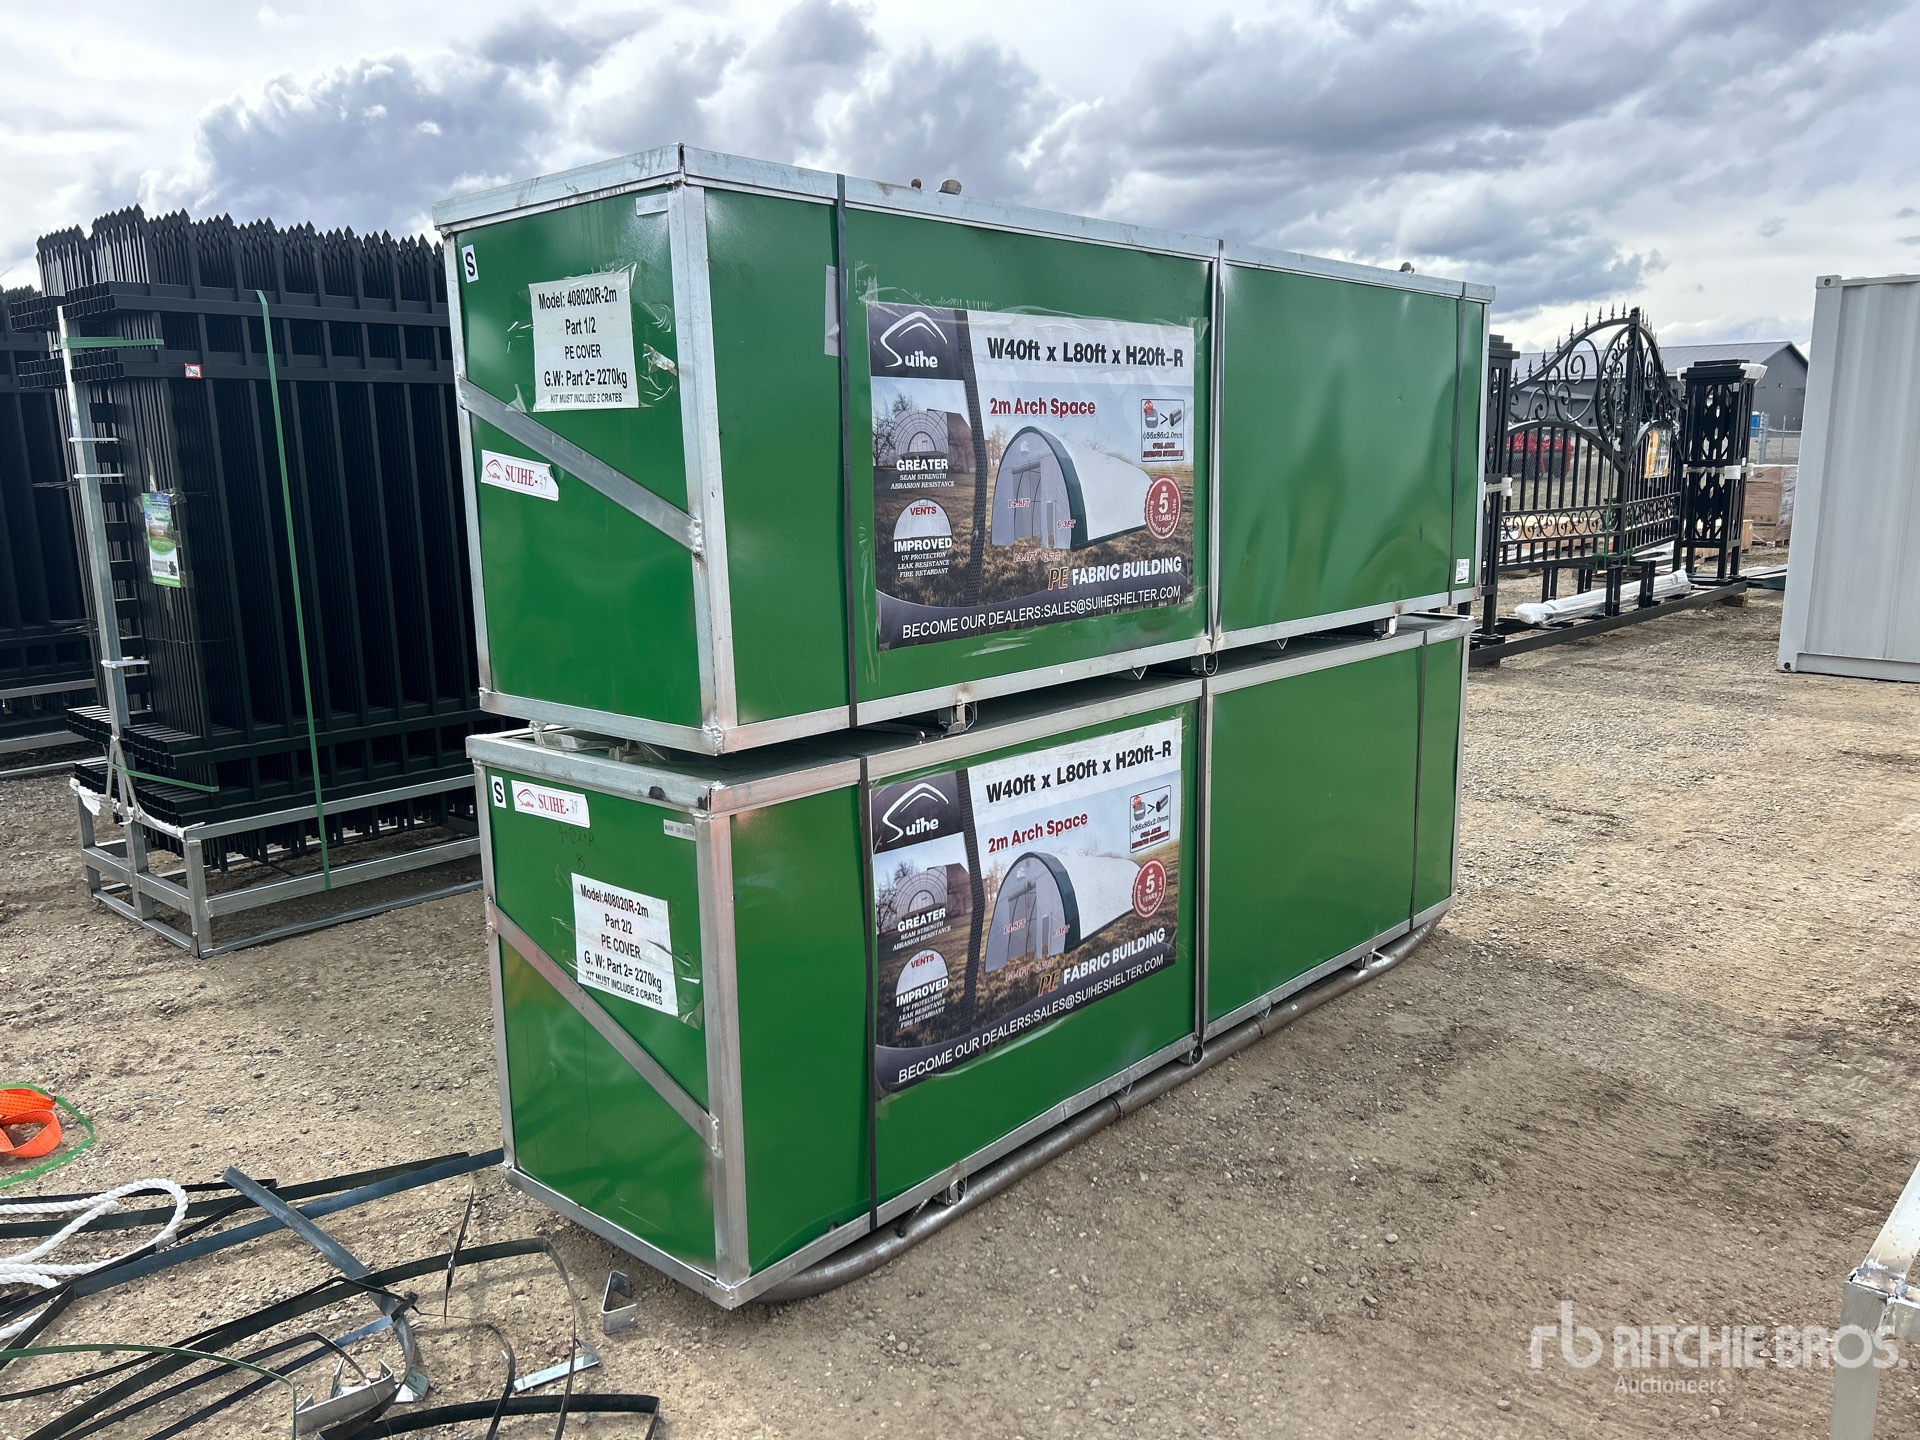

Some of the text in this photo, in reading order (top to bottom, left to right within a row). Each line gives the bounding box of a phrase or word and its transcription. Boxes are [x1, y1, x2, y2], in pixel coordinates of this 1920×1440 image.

[465, 251, 476, 277] S
[538, 286, 617, 310] Model: 408020R-2m
[565, 317, 597, 335] Part 1/2
[565, 344, 602, 359] PE COVER
[987, 337, 1184, 368] W40ft x L80ft x H20ft-R
[544, 368, 628, 389] G.W: Part 2= 2270kg
[550, 393, 623, 404] KIT MUST INCLUDE 2 CRATES
[989, 397, 1096, 418] 2m Arch Space
[896, 458, 948, 472] GREATER
[890, 482, 920, 490] ABRASION
[910, 506, 937, 516] VENTS
[1158, 492, 1169, 514] 5
[1155, 514, 1172, 522] YEARS
[894, 538, 953, 553] IMPROVED
[910, 552, 946, 561] PROTECTION
[898, 560, 950, 570] LEAK RESISTANCE
[900, 568, 949, 578] FIRE RETARDANT
[1048, 556, 1182, 590] PE FABRIC BUILDING
[902, 618, 959, 639] BECOME
[960, 613, 986, 630] OUR
[986, 740, 1172, 803] W40ft x L80ft x H20ft-R
[494, 781, 504, 804] S
[988, 813, 1088, 854] 2m Arch Space
[1145, 873, 1155, 894] 5
[605, 913, 633, 935] Part 2/2
[897, 907, 946, 932] GREATER
[900, 921, 944, 940] SEAM STRENGTH
[601, 934, 641, 960] PE COVER
[892, 925, 952, 951] ABRASION RESISTANCE
[911, 953, 935, 969] VENTS
[1037, 969, 1061, 997] PE
[1063, 952, 1110, 985] FABRIC
[1112, 927, 1166, 964] BUILDING
[607, 958, 622, 976] Part
[624, 964, 633, 977] 2=
[635, 968, 662, 992] 2270kg
[595, 971, 610, 985] MUST
[611, 980, 635, 996] INCLUDE
[636, 988, 640, 997] 2
[640, 990, 663, 1005] CRATES
[896, 977, 949, 1008] IMPROVED
[899, 998, 946, 1022] LEAK RESISTANCE
[911, 992, 943, 1010] PROTECTION
[914, 1006, 945, 1025] RETARDANT
[899, 1048, 953, 1083] BECOME
[955, 1037, 980, 1057] OUR
